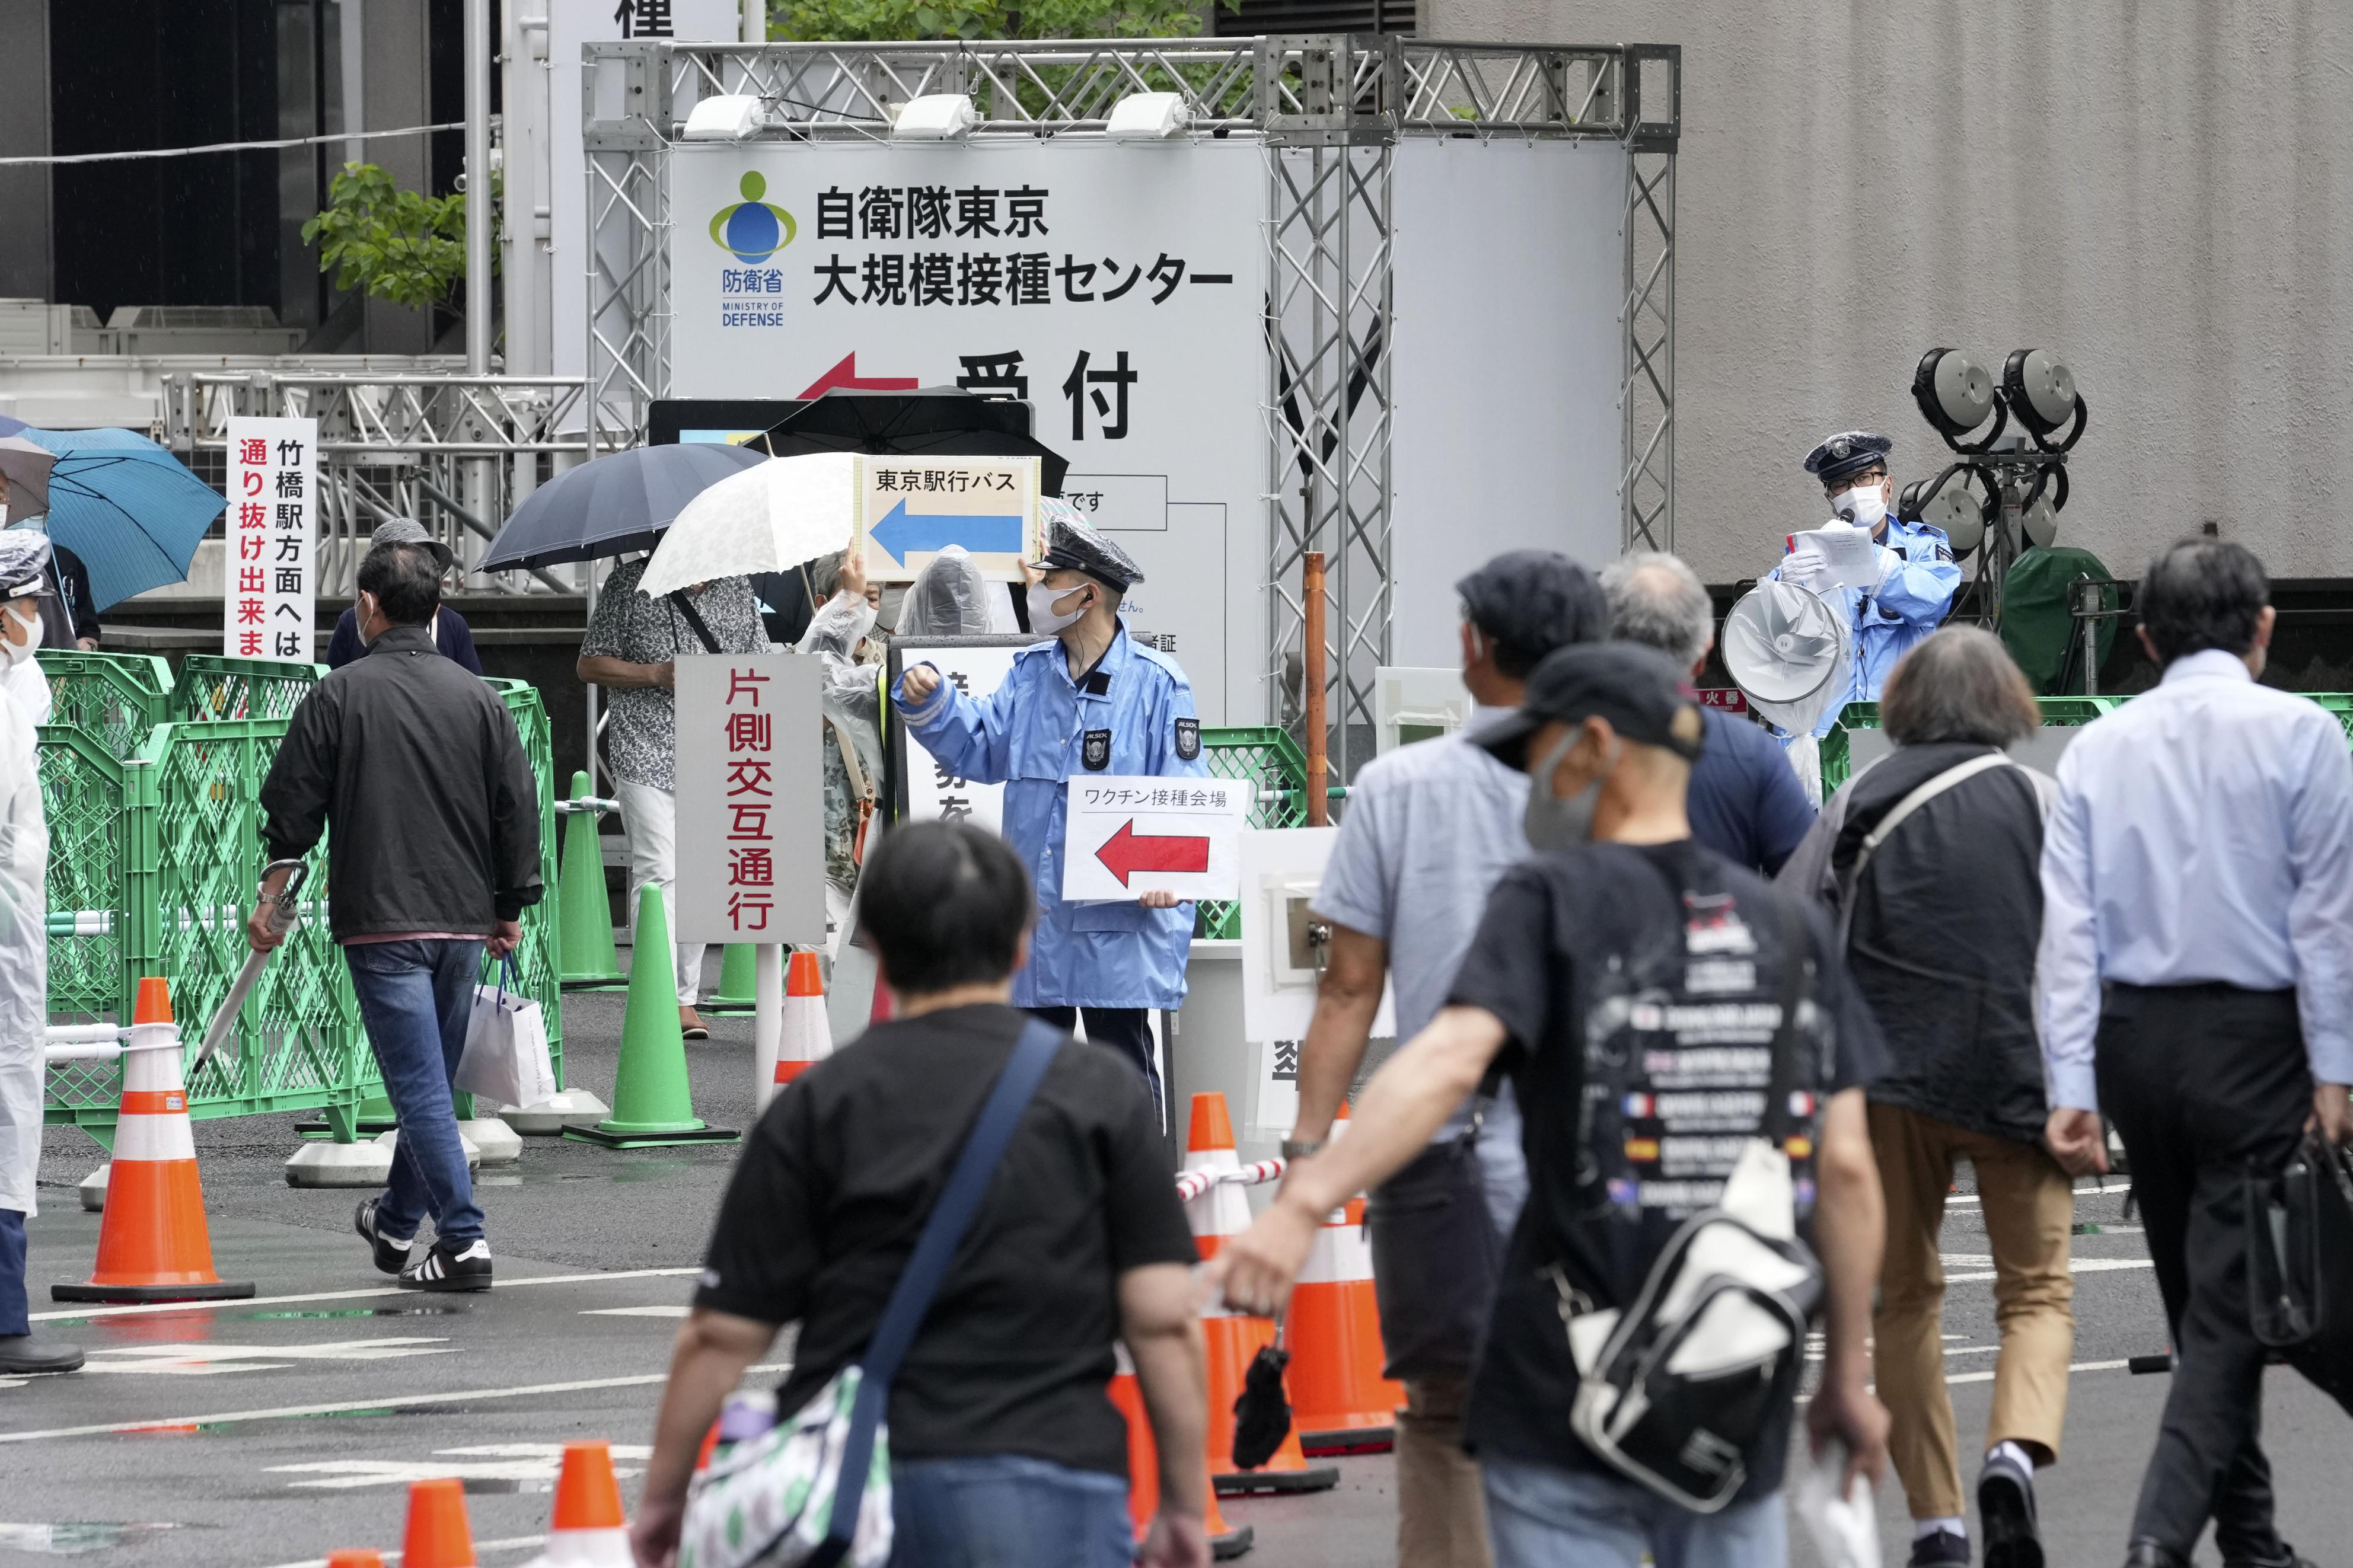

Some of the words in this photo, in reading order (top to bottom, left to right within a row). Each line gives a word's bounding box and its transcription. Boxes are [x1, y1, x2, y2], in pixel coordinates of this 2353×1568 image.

[816, 185, 1050, 240] 自衛隊東京
[722, 269, 783, 293] 防衛省
[814, 251, 1233, 306] 大規模接種センター
[722, 302, 769, 311] MINISTRY
[771, 302, 783, 311] OF
[722, 313, 783, 327] DEFENSE
[876, 469, 1016, 493] 東京駅行バス
[1059, 491, 1104, 513] です
[237, 438, 267, 656] 通り抜け出来ま
[275, 439, 304, 657] 竹橋駅方面へは
[1695, 691, 1739, 705] 火器
[724, 668, 774, 932] 片側交互通行
[1085, 788, 1227, 808] ワクチン接種会場
